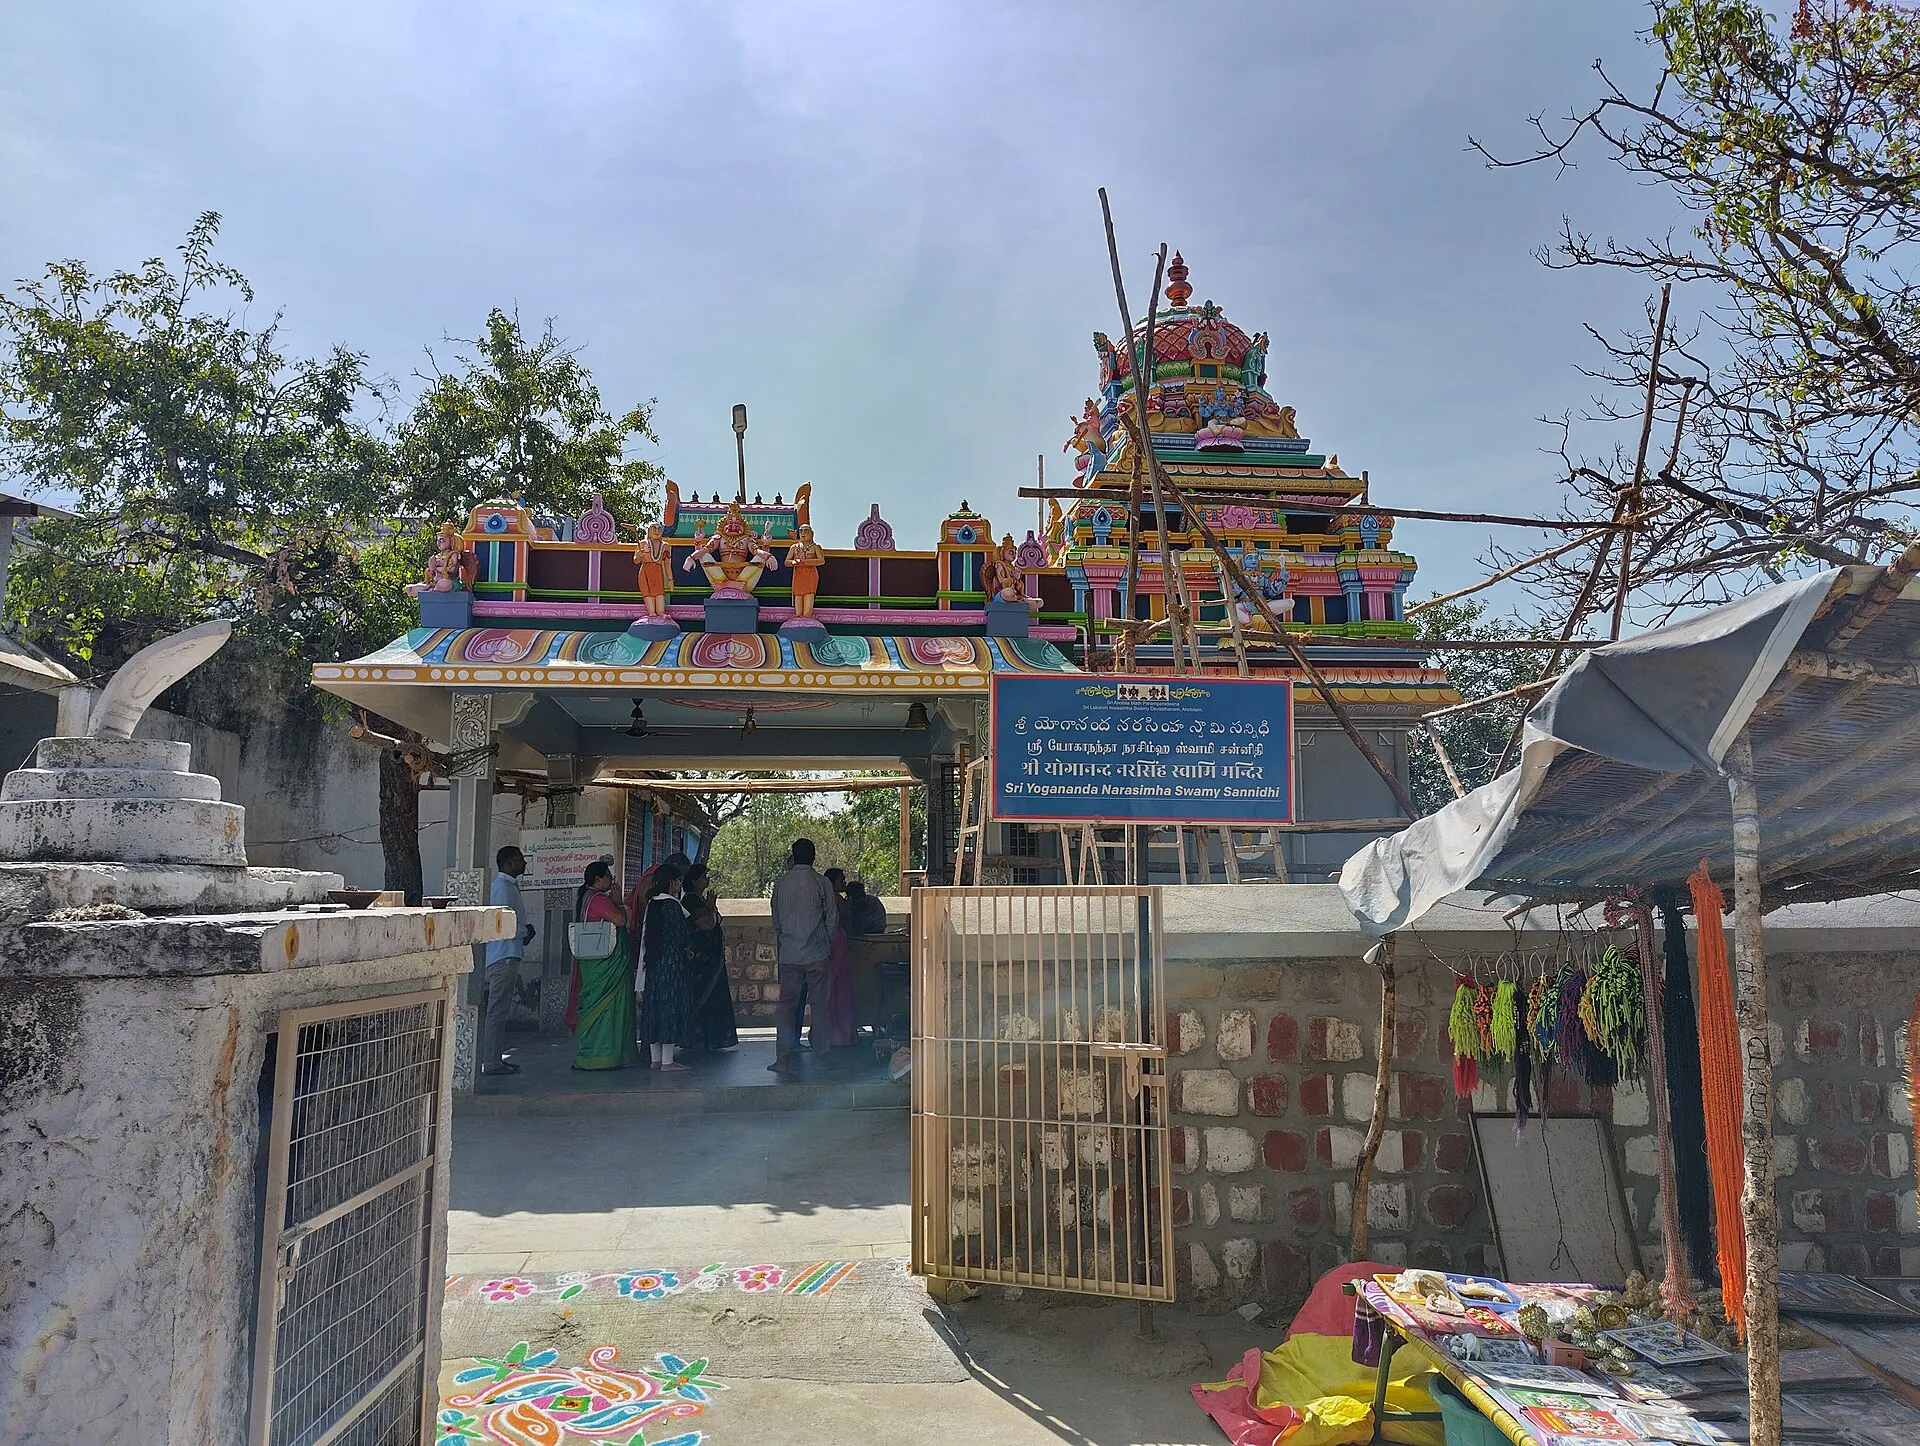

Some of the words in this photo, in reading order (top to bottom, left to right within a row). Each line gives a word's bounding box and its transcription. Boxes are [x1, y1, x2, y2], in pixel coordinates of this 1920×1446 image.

[1014, 716, 1028, 735] శ్రీ
[1034, 716, 1112, 732] యోగానంద
[1116, 717, 1184, 733] నరసింహ
[1229, 719, 1270, 739] సన్నిధి
[1020, 758, 1041, 776] श्री
[1043, 758, 1113, 778] योगानन्द
[1115, 760, 1168, 778] नरसिंह
[1220, 761, 1265, 781] मन्दिर
[1005, 782, 1024, 794] Sri
[1027, 783, 1098, 797] Yogananda
[1101, 784, 1172, 797] Narasimha
[1174, 785, 1221, 799] Swamy
[1223, 786, 1280, 798] Sannidhi
